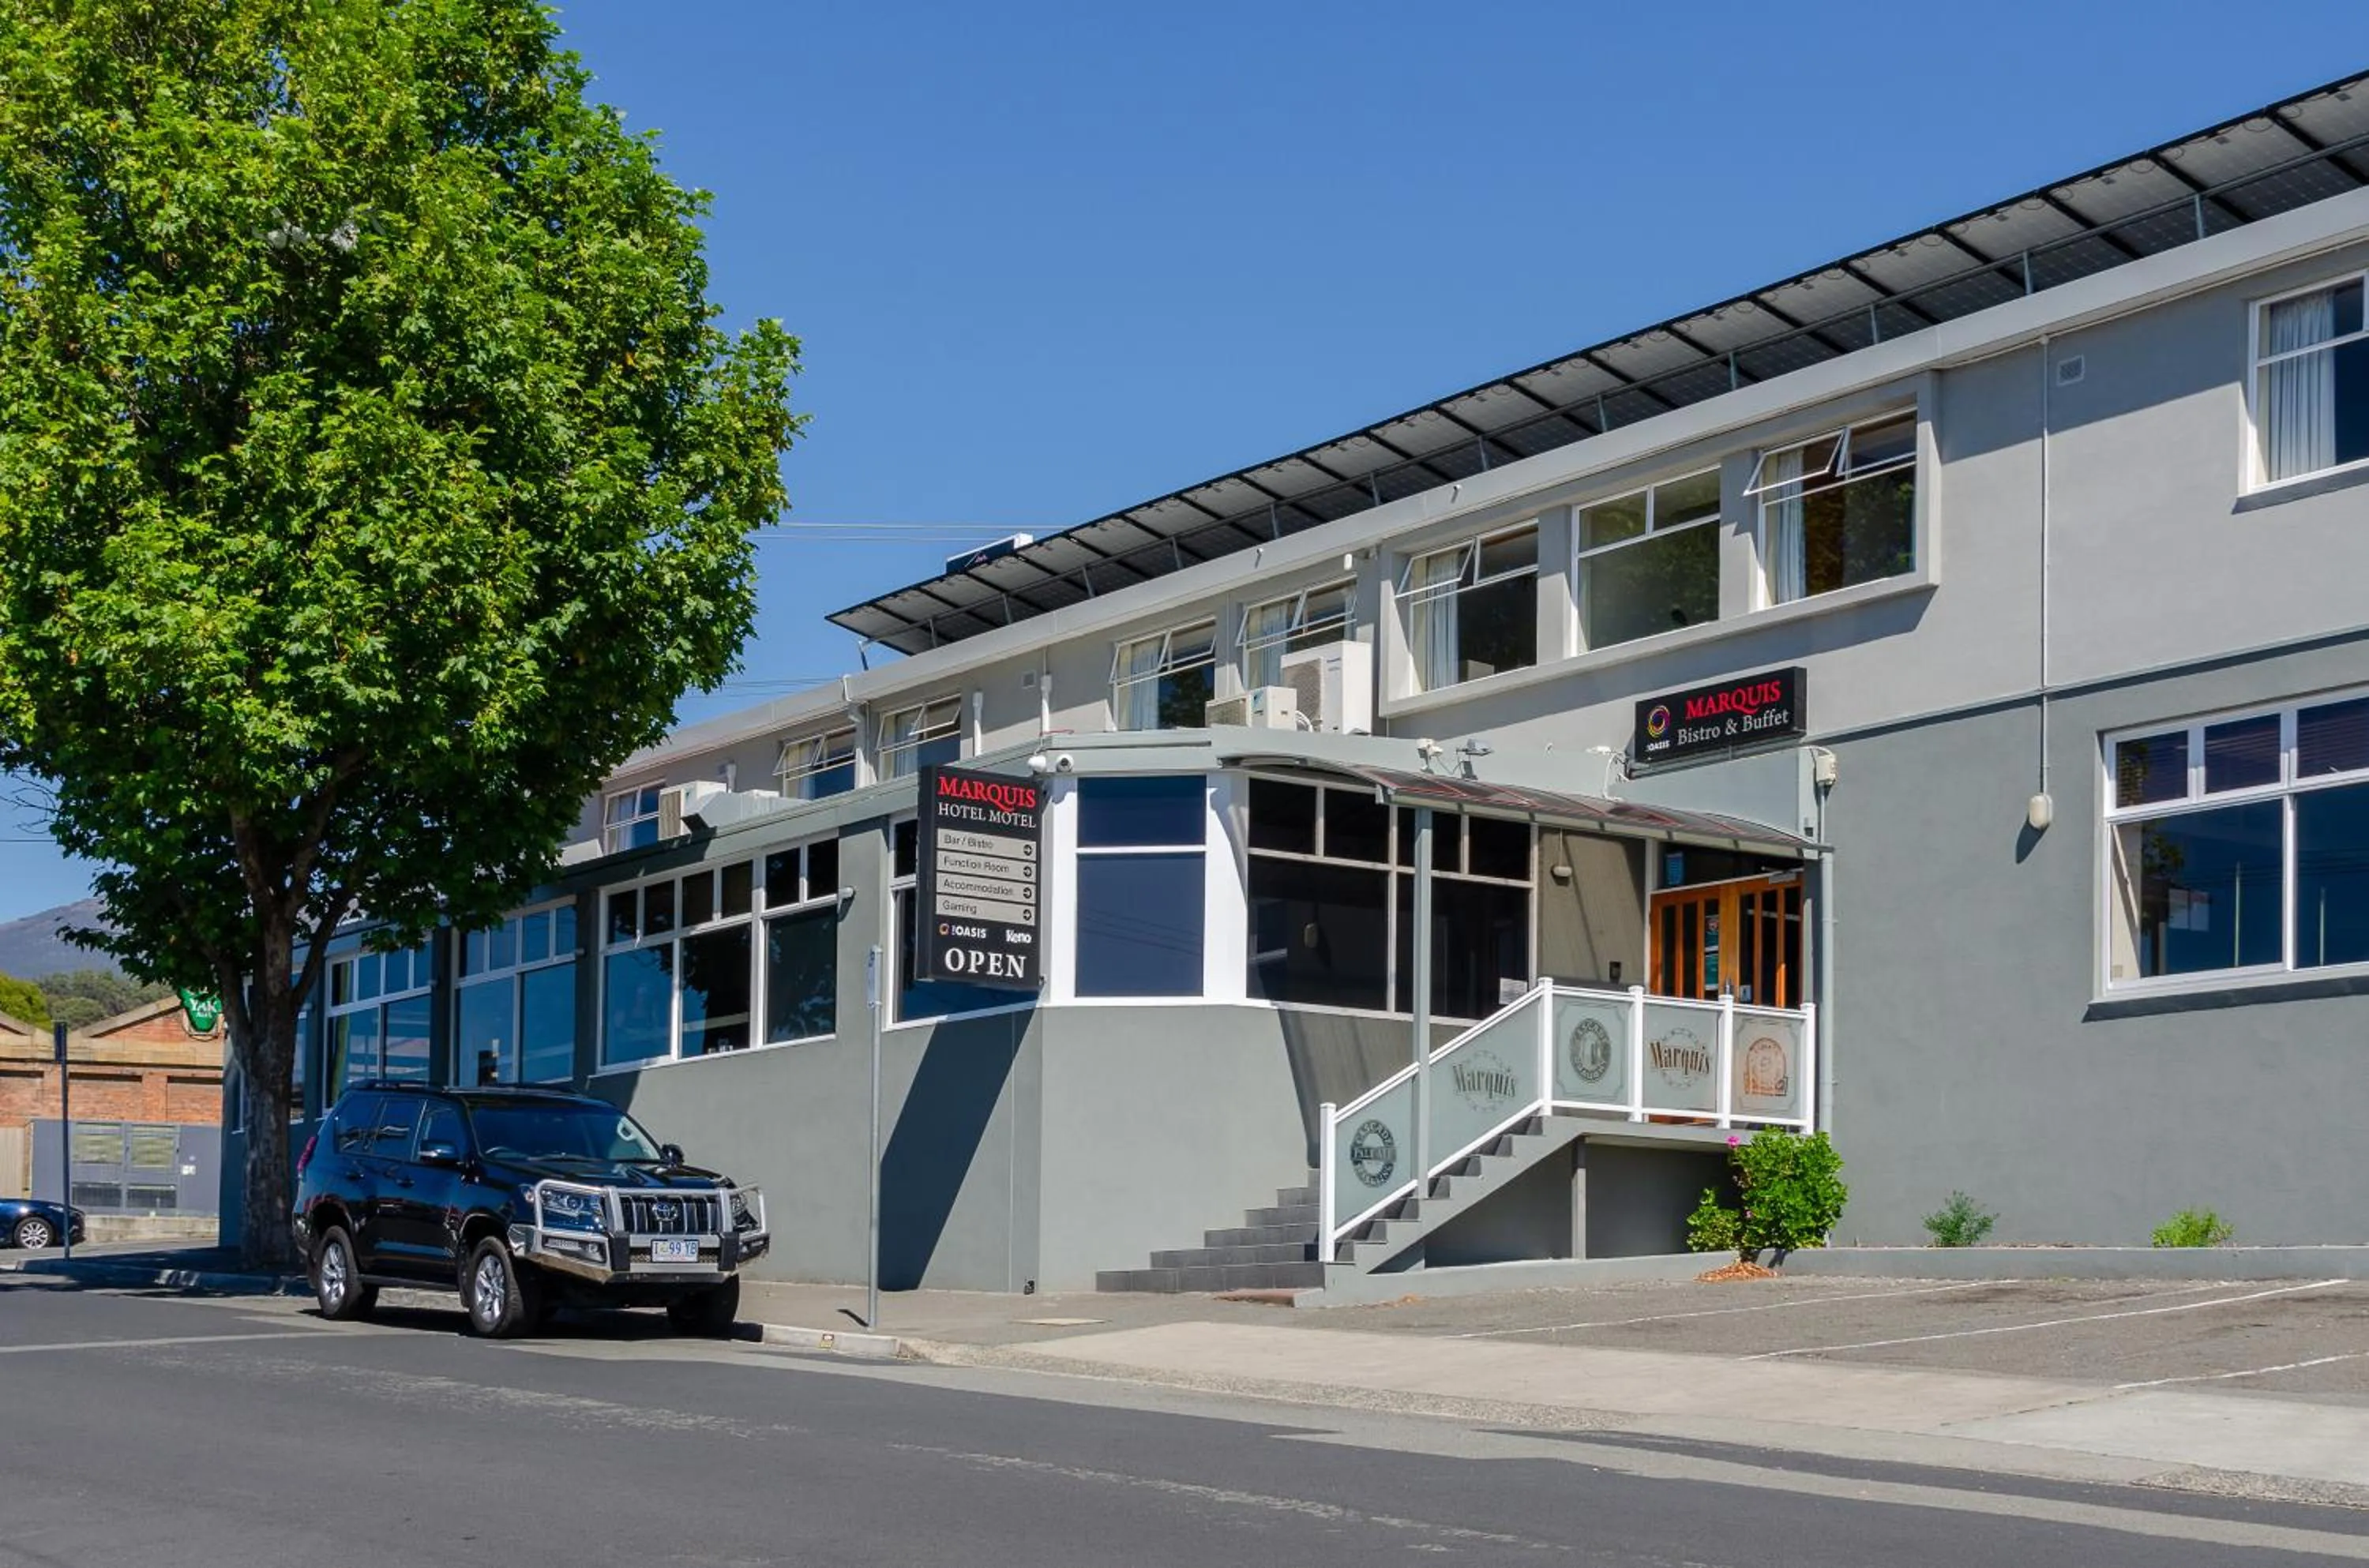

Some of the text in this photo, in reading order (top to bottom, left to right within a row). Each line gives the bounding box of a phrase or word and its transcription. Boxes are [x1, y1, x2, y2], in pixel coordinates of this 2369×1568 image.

[1685, 680, 1781, 720] MARQUIS
[1677, 709, 1789, 746] Bistro & Buffet
[937, 776, 1036, 812] MARQUIS
[938, 802, 1036, 828] HOTEL MOTEL
[944, 835, 961, 845] Bar
[967, 838, 993, 850] Bistro
[944, 856, 1010, 872] Function Room
[944, 879, 1013, 895] Accommodation
[942, 900, 977, 915] Gaming
[955, 925, 986, 939] OASIS
[1005, 929, 1032, 943] Keno
[944, 947, 1027, 978] OPEN
[1650, 1041, 1710, 1076] Marquis
[1452, 1063, 1515, 1100] Marquis
